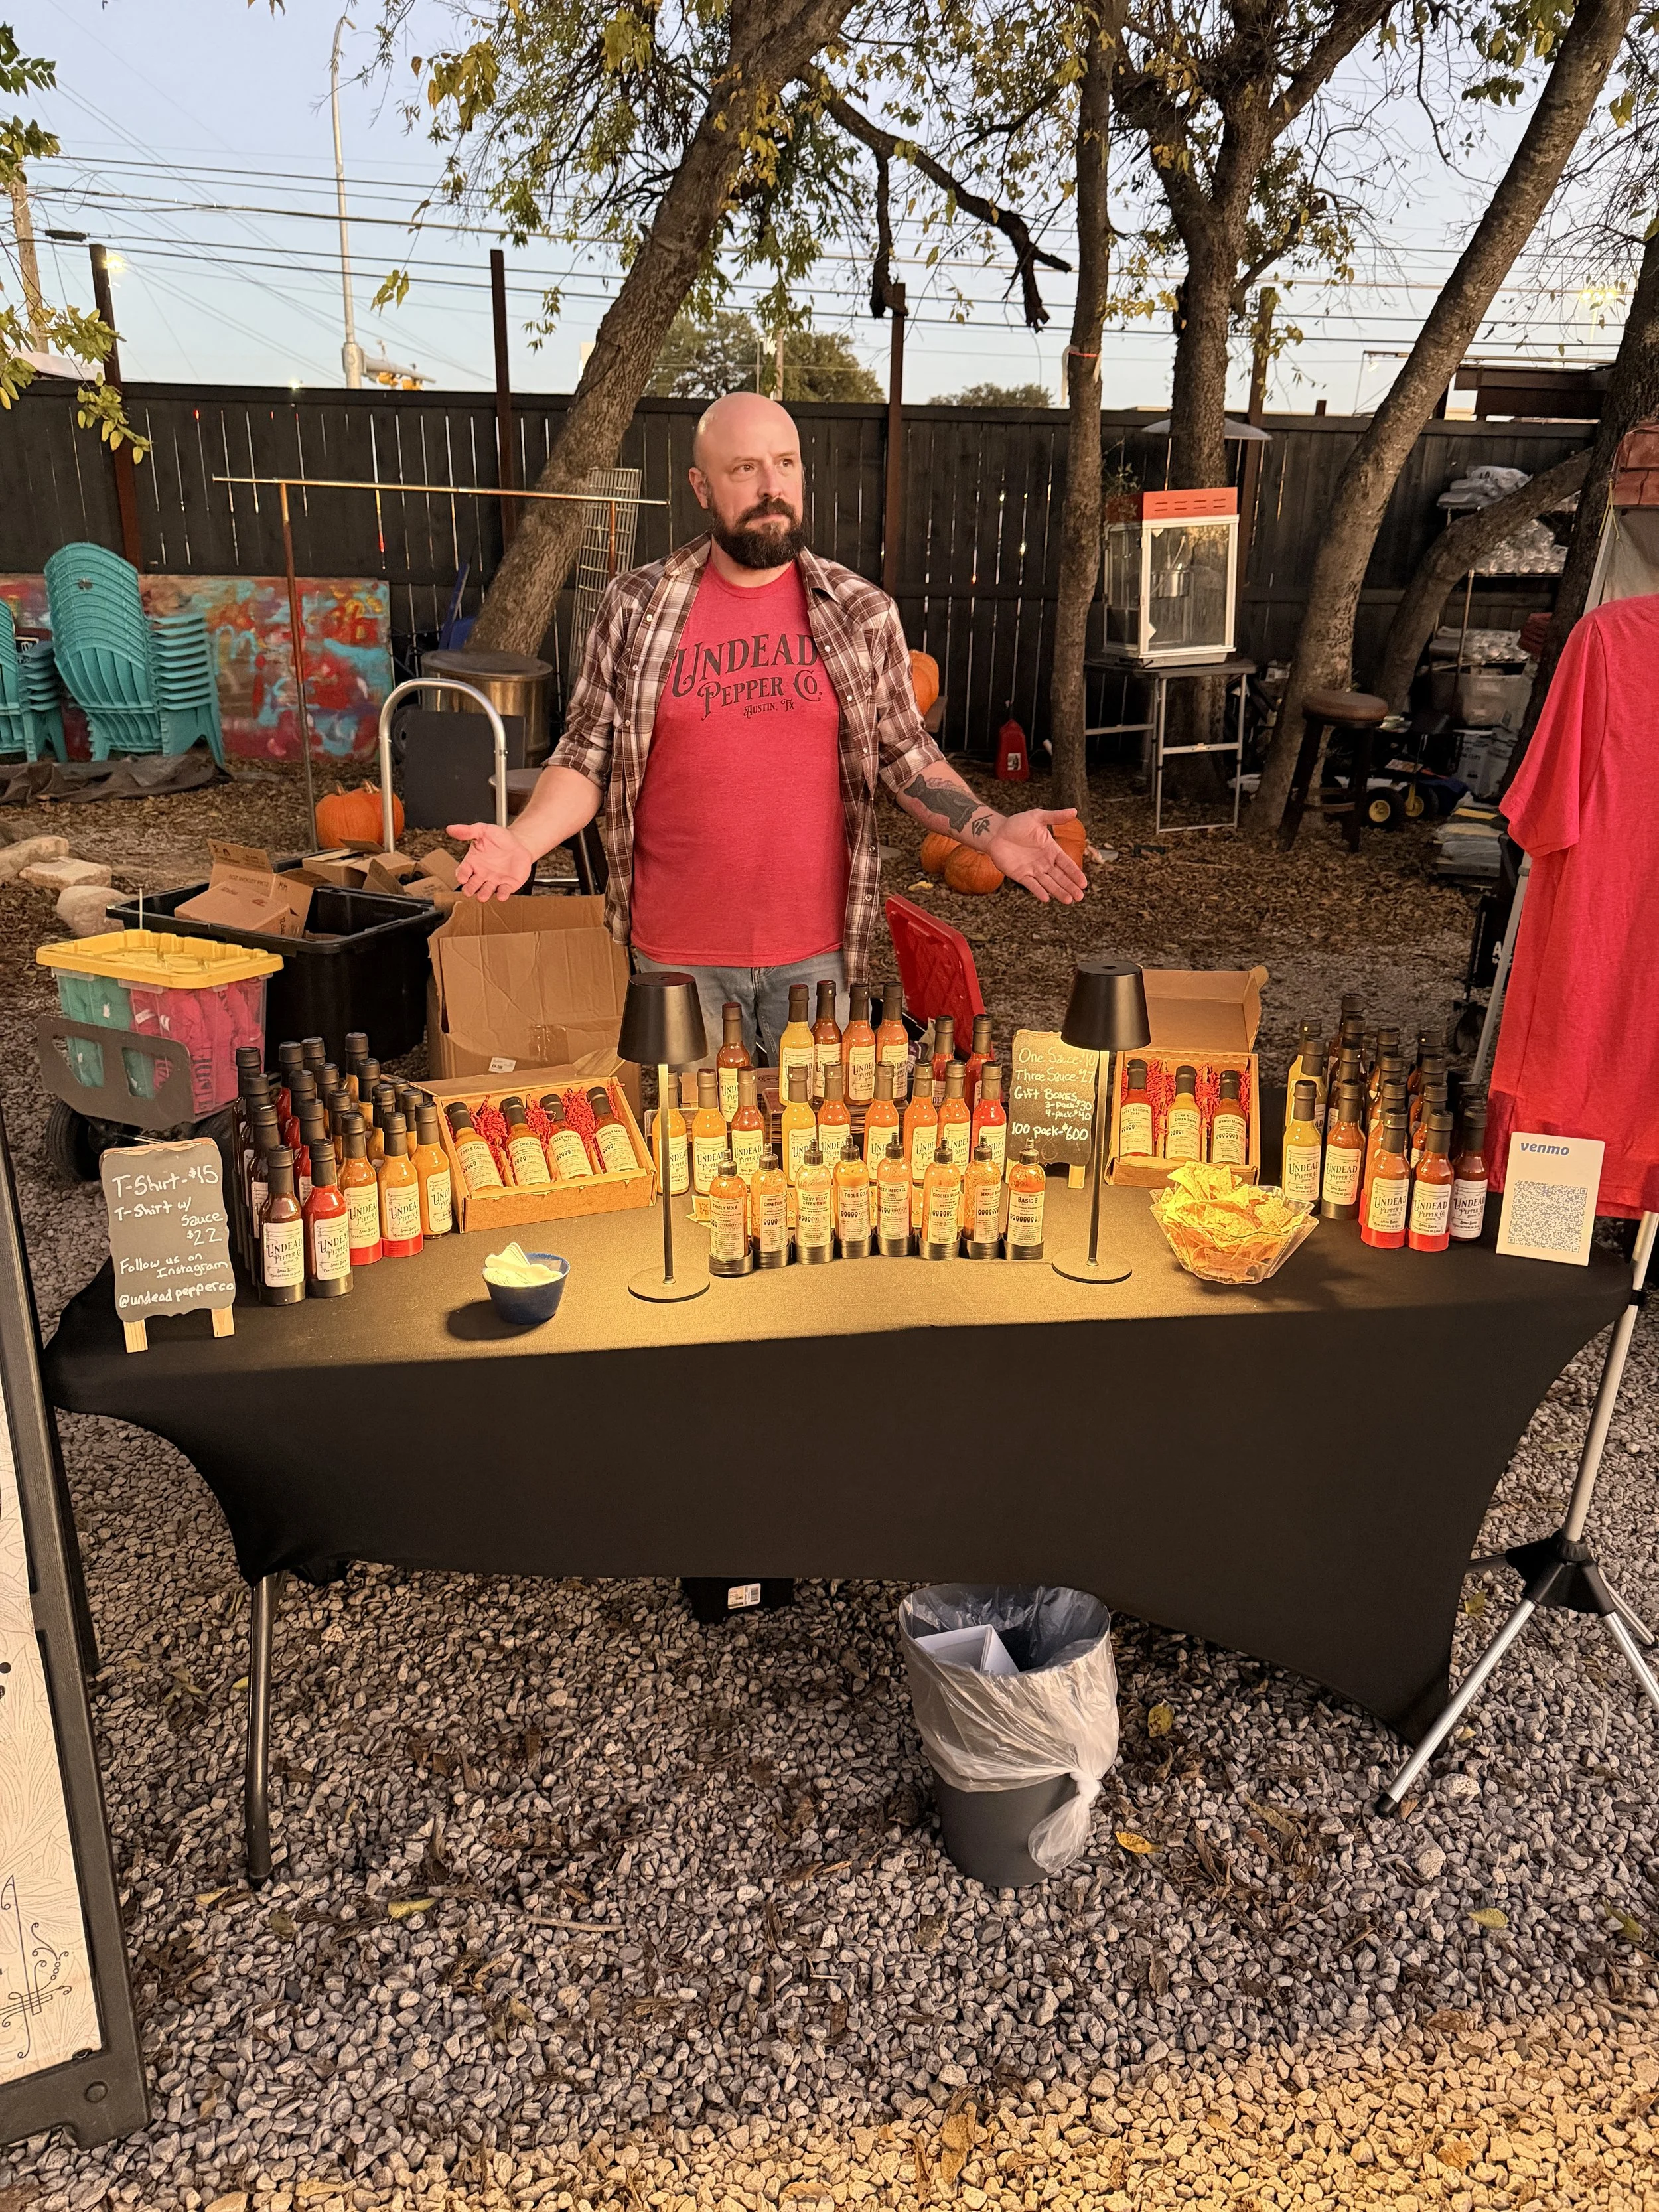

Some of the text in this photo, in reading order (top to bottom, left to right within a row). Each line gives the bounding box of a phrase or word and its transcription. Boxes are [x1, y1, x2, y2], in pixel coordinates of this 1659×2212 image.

[671, 634, 820, 698] UNDEAD
[697, 676, 784, 721] PEPPER
[1019, 1047, 1045, 1063] One
[1015, 1069, 1046, 1082] Three
[1012, 1122, 1030, 1135] 100
[1520, 1142, 1570, 1156] venmo
[1288, 1161, 1319, 1175] UNDEAD
[1327, 1163, 1358, 1175] UNDEAD
[1374, 1195, 1406, 1208] UNDEAD
[1413, 1200, 1447, 1211] UNDEAD
[186, 1228, 223, 1246] $22
[266, 1238, 303, 1258] UNDEAD
[120, 1253, 203, 1275] Follow us on
[156, 1261, 229, 1278] Instagram
